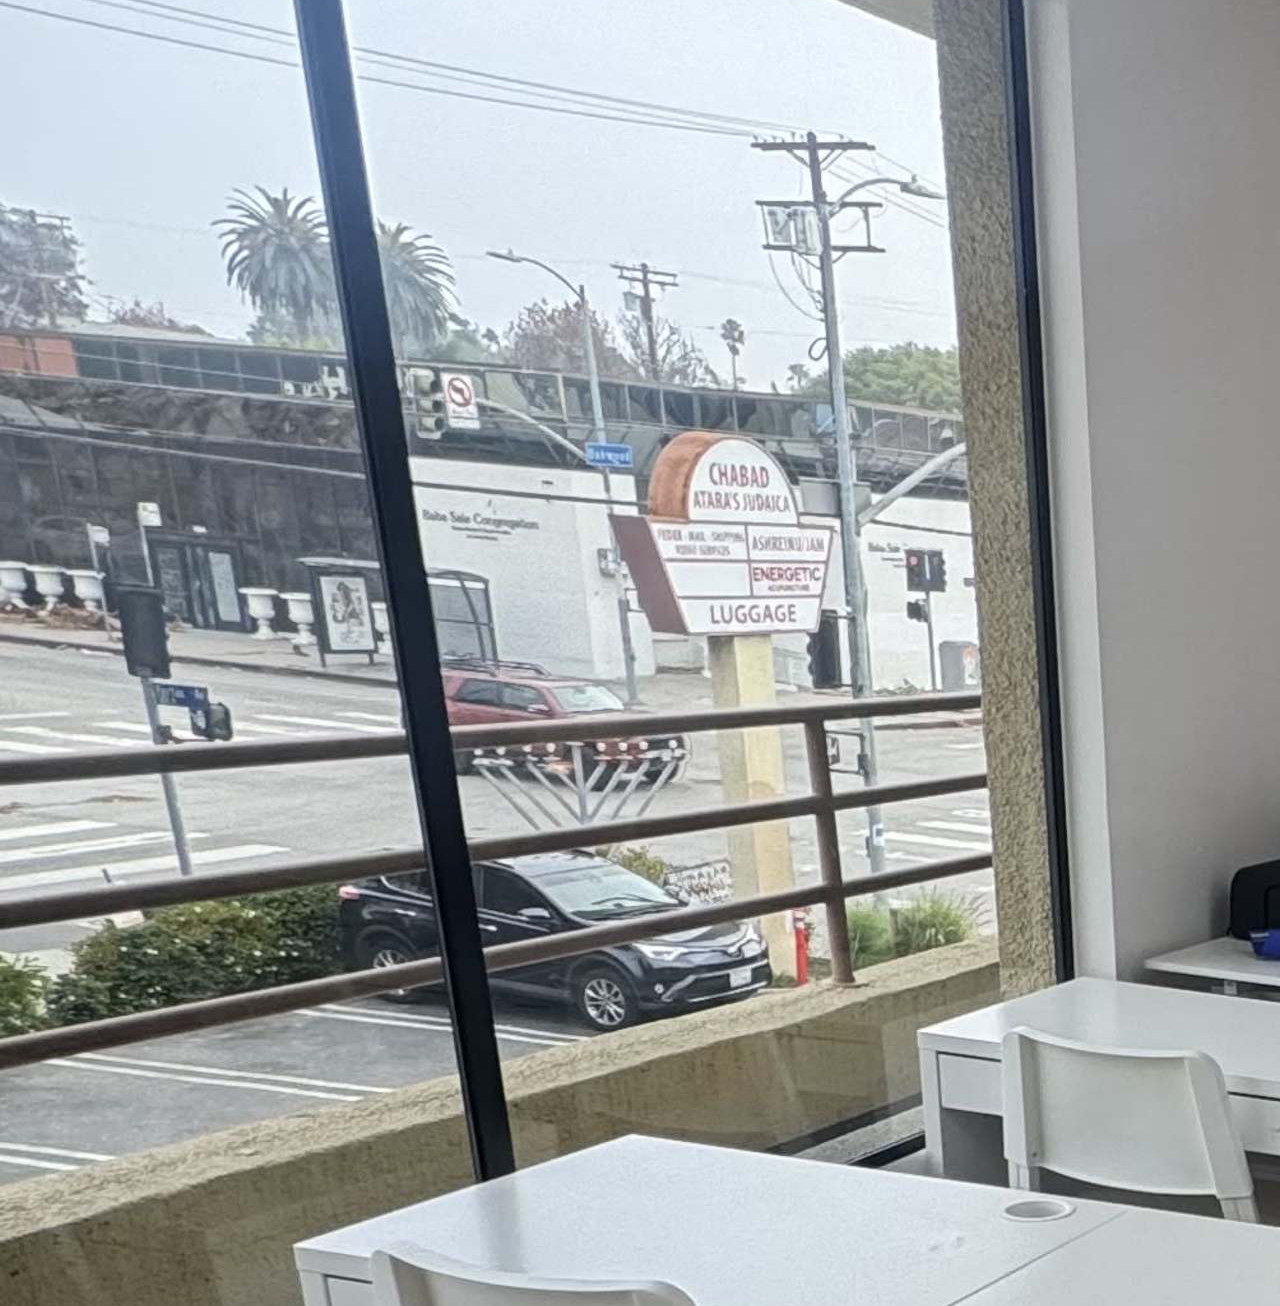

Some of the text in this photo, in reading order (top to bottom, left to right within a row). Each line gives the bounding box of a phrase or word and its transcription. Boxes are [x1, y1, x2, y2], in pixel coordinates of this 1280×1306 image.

[709, 462, 769, 488] CHABAD
[693, 492, 791, 512] ATARA'S JUDAICA
[753, 566, 821, 582] ENERGETIC
[710, 603, 797, 625] LUGGAGE
